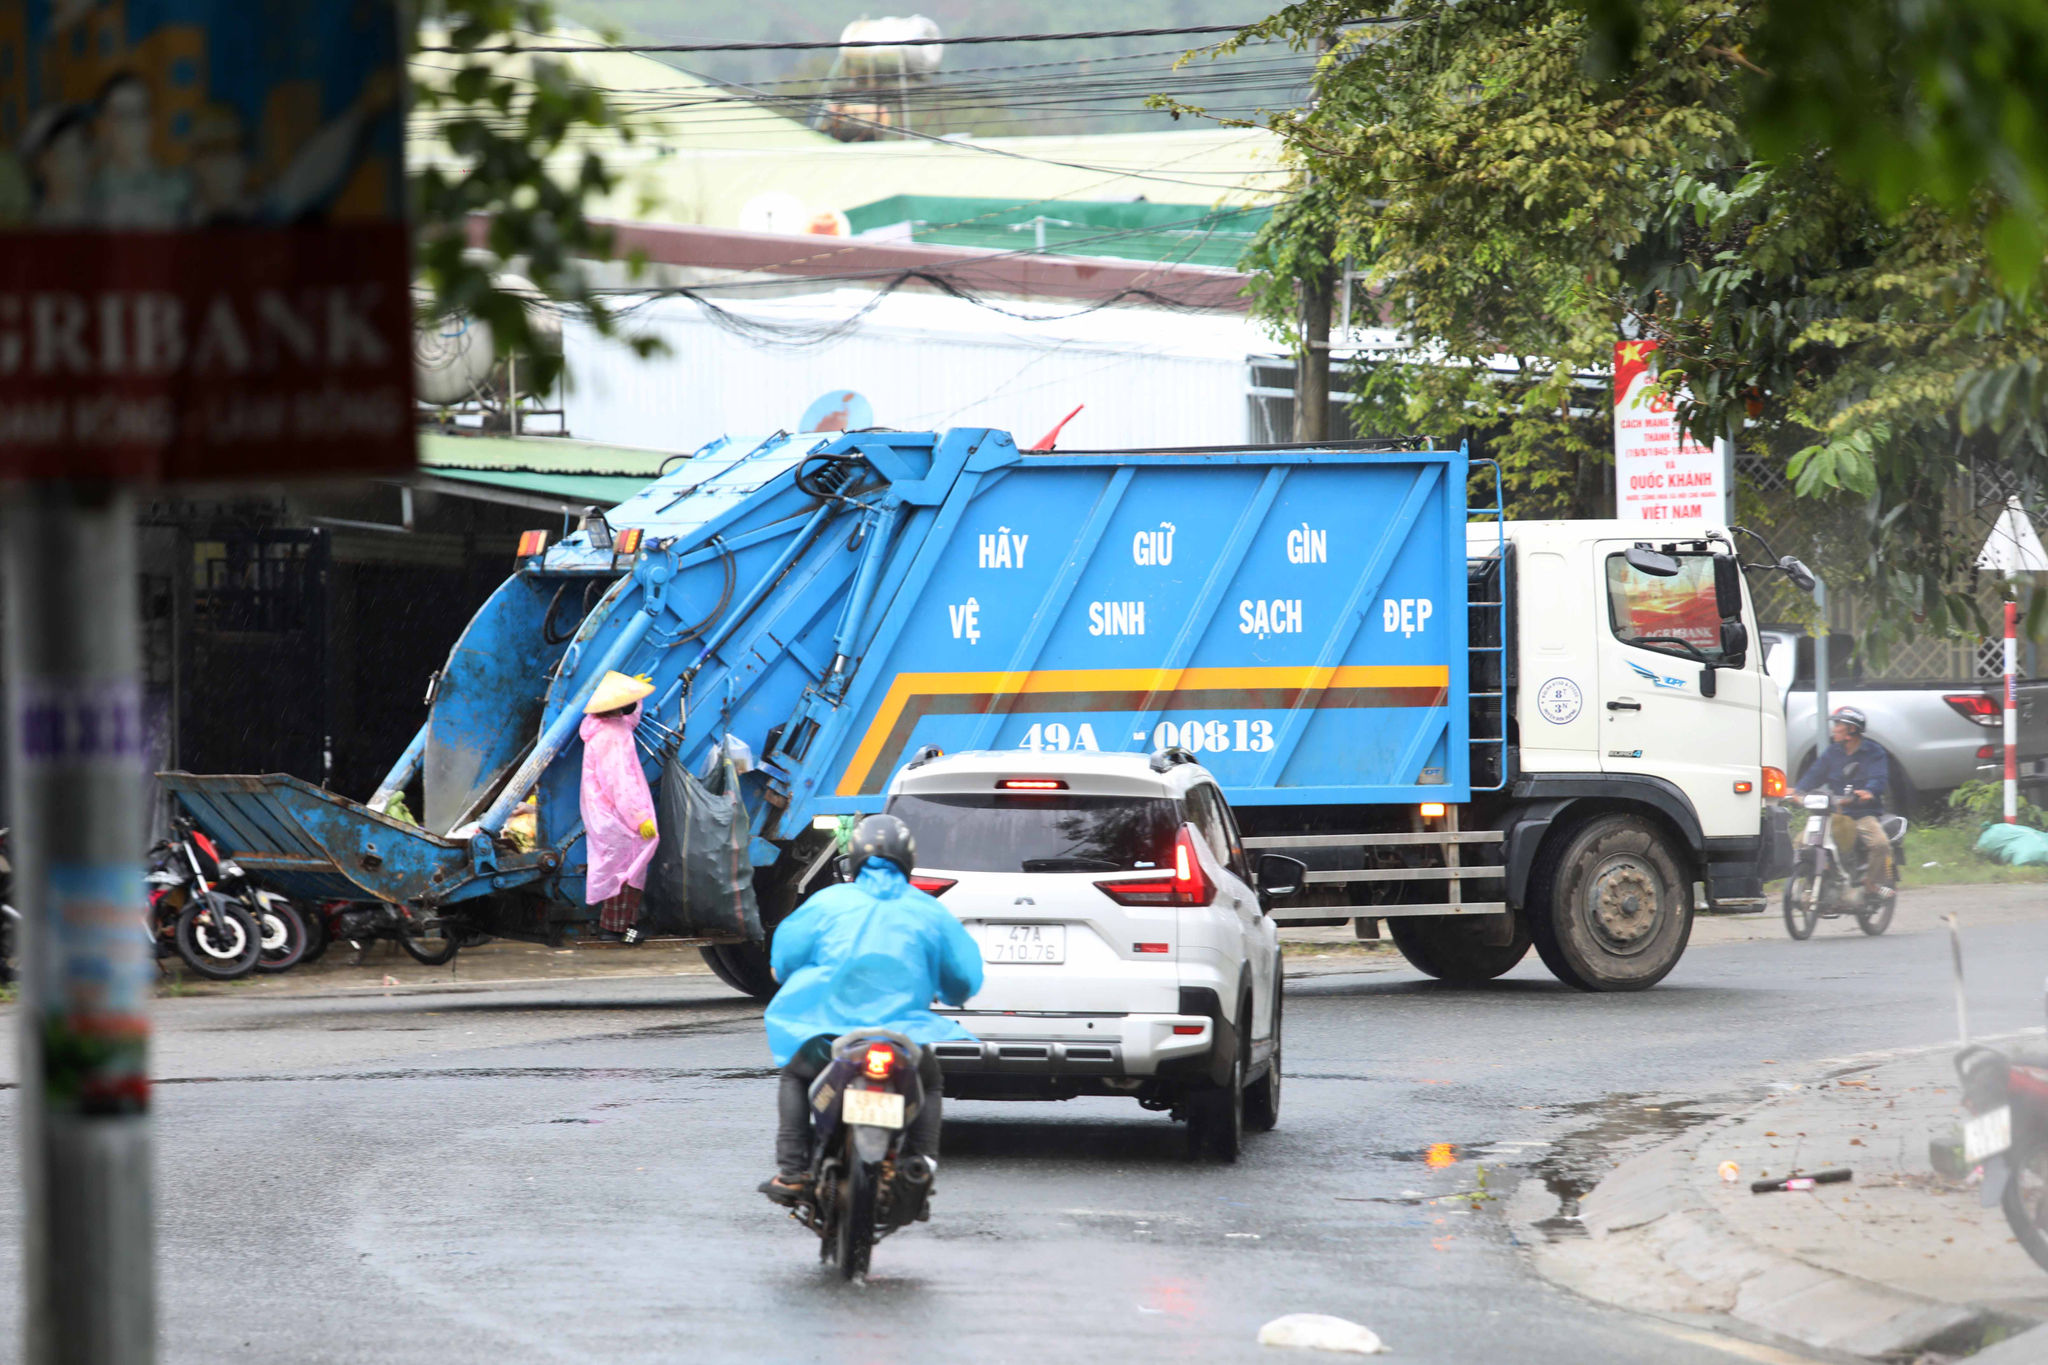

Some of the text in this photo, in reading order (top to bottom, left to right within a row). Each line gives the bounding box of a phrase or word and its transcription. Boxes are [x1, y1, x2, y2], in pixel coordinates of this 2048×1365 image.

[1630, 470, 1712, 490] QUỐC KHÁNH
[1672, 504, 1702, 519] NAM
[979, 521, 1327, 569] HÃY GIỮ GÌN
[948, 597, 1433, 645] VỆ SINH SẠCH ĐẸP
[1018, 722, 1100, 752] 49A
[1009, 926, 1042, 942] 47A
[995, 944, 1056, 960] 710.76
